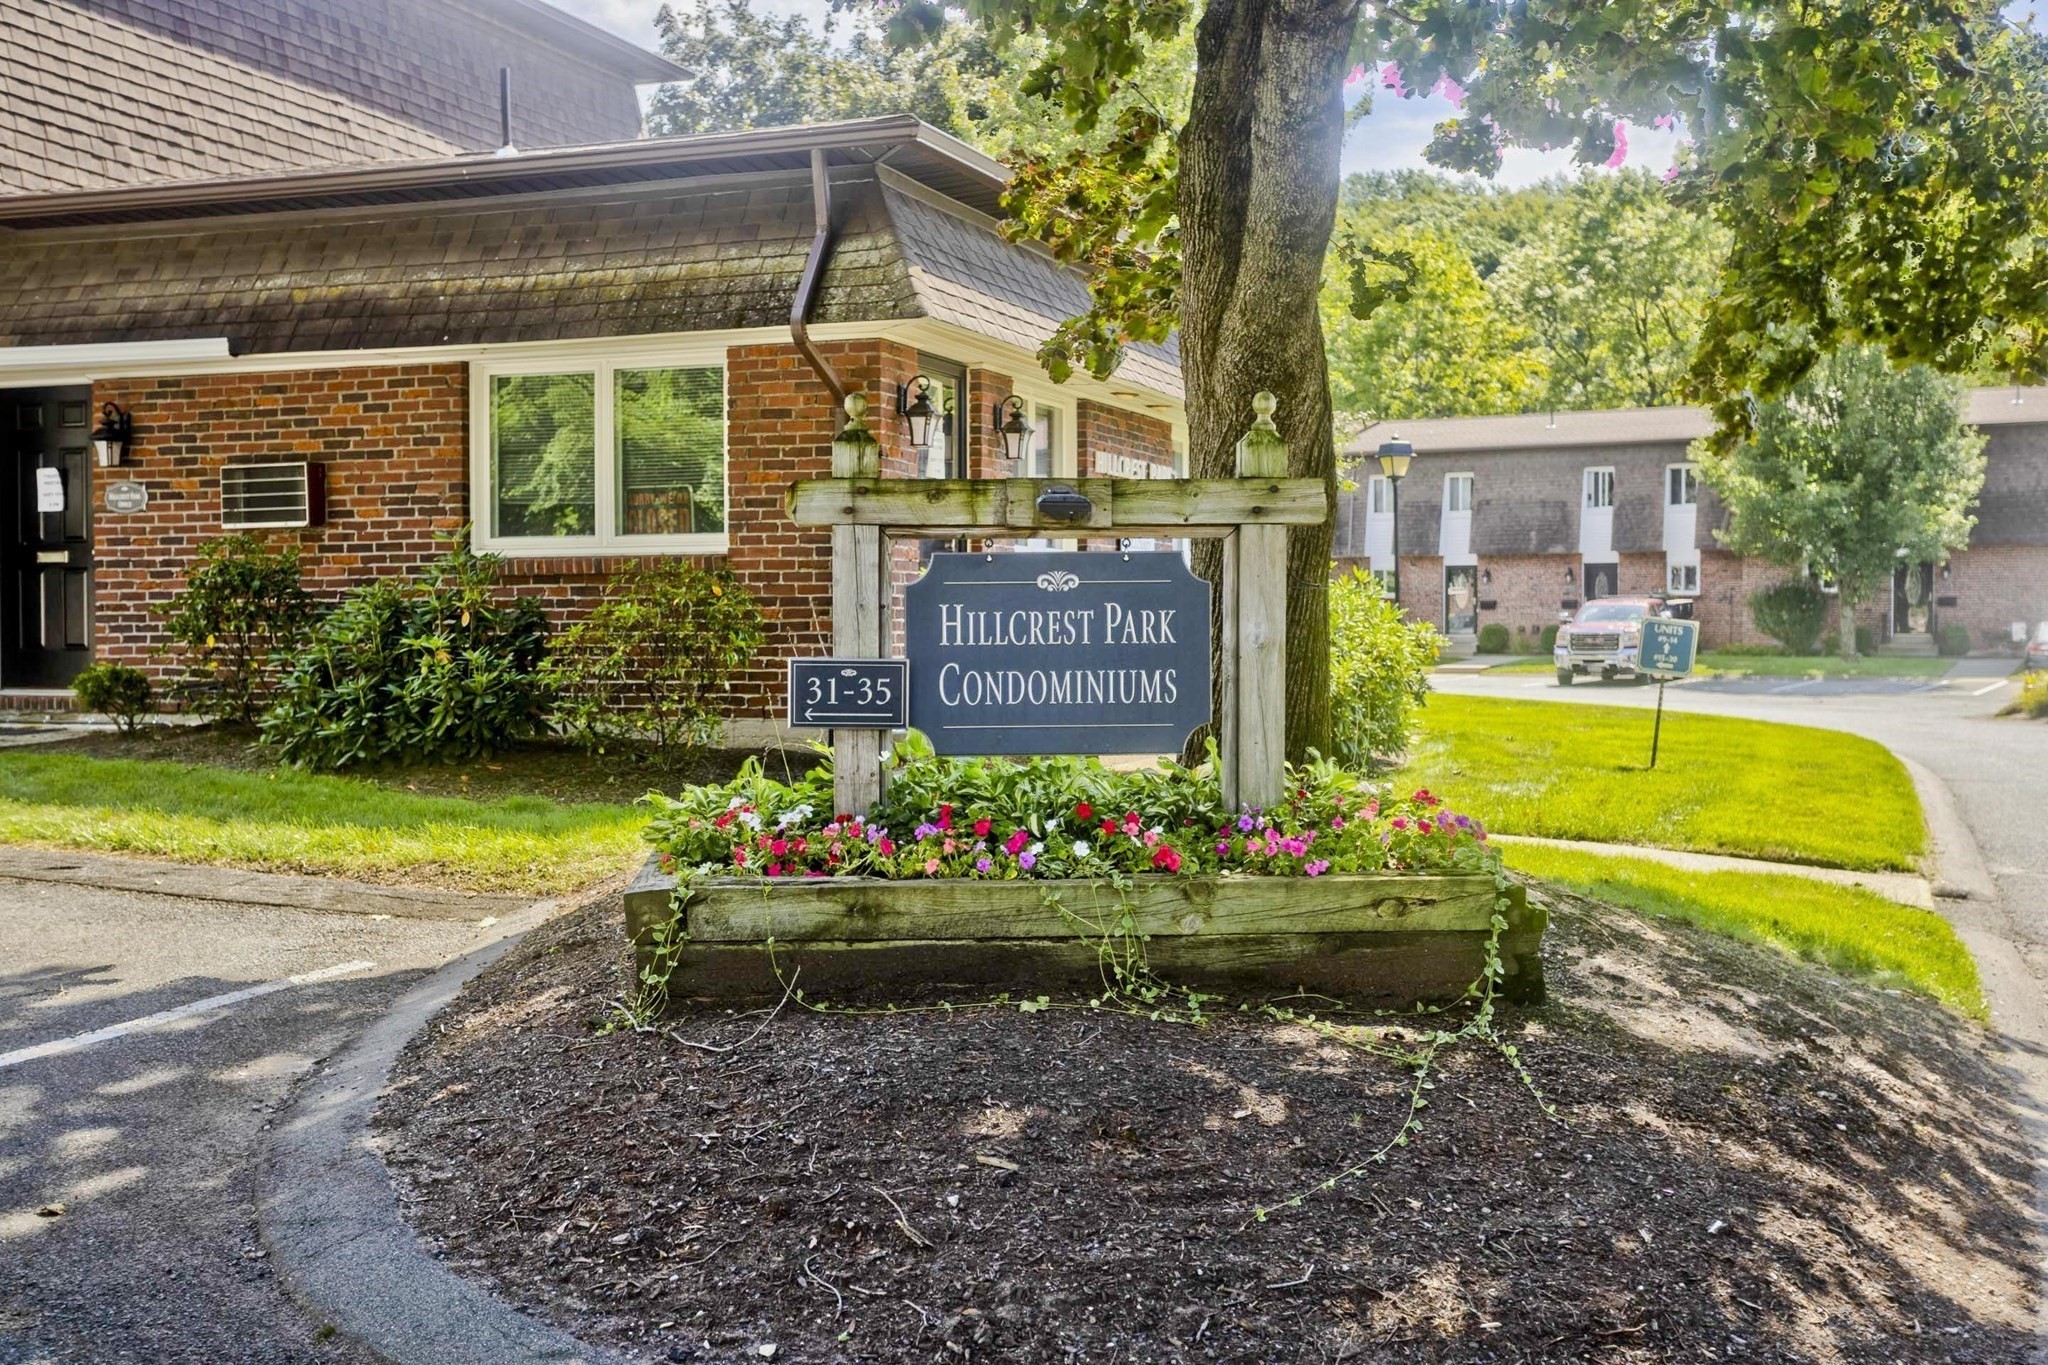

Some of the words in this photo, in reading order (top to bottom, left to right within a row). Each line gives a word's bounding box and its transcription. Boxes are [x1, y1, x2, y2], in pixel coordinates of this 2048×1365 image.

[939, 603, 1094, 646] HILLCREST
[1103, 602, 1177, 645] PARK
[1654, 624, 1684, 636] UNITS
[806, 677, 892, 705] 31-35
[939, 663, 1178, 706] CONDOMINIUMS
